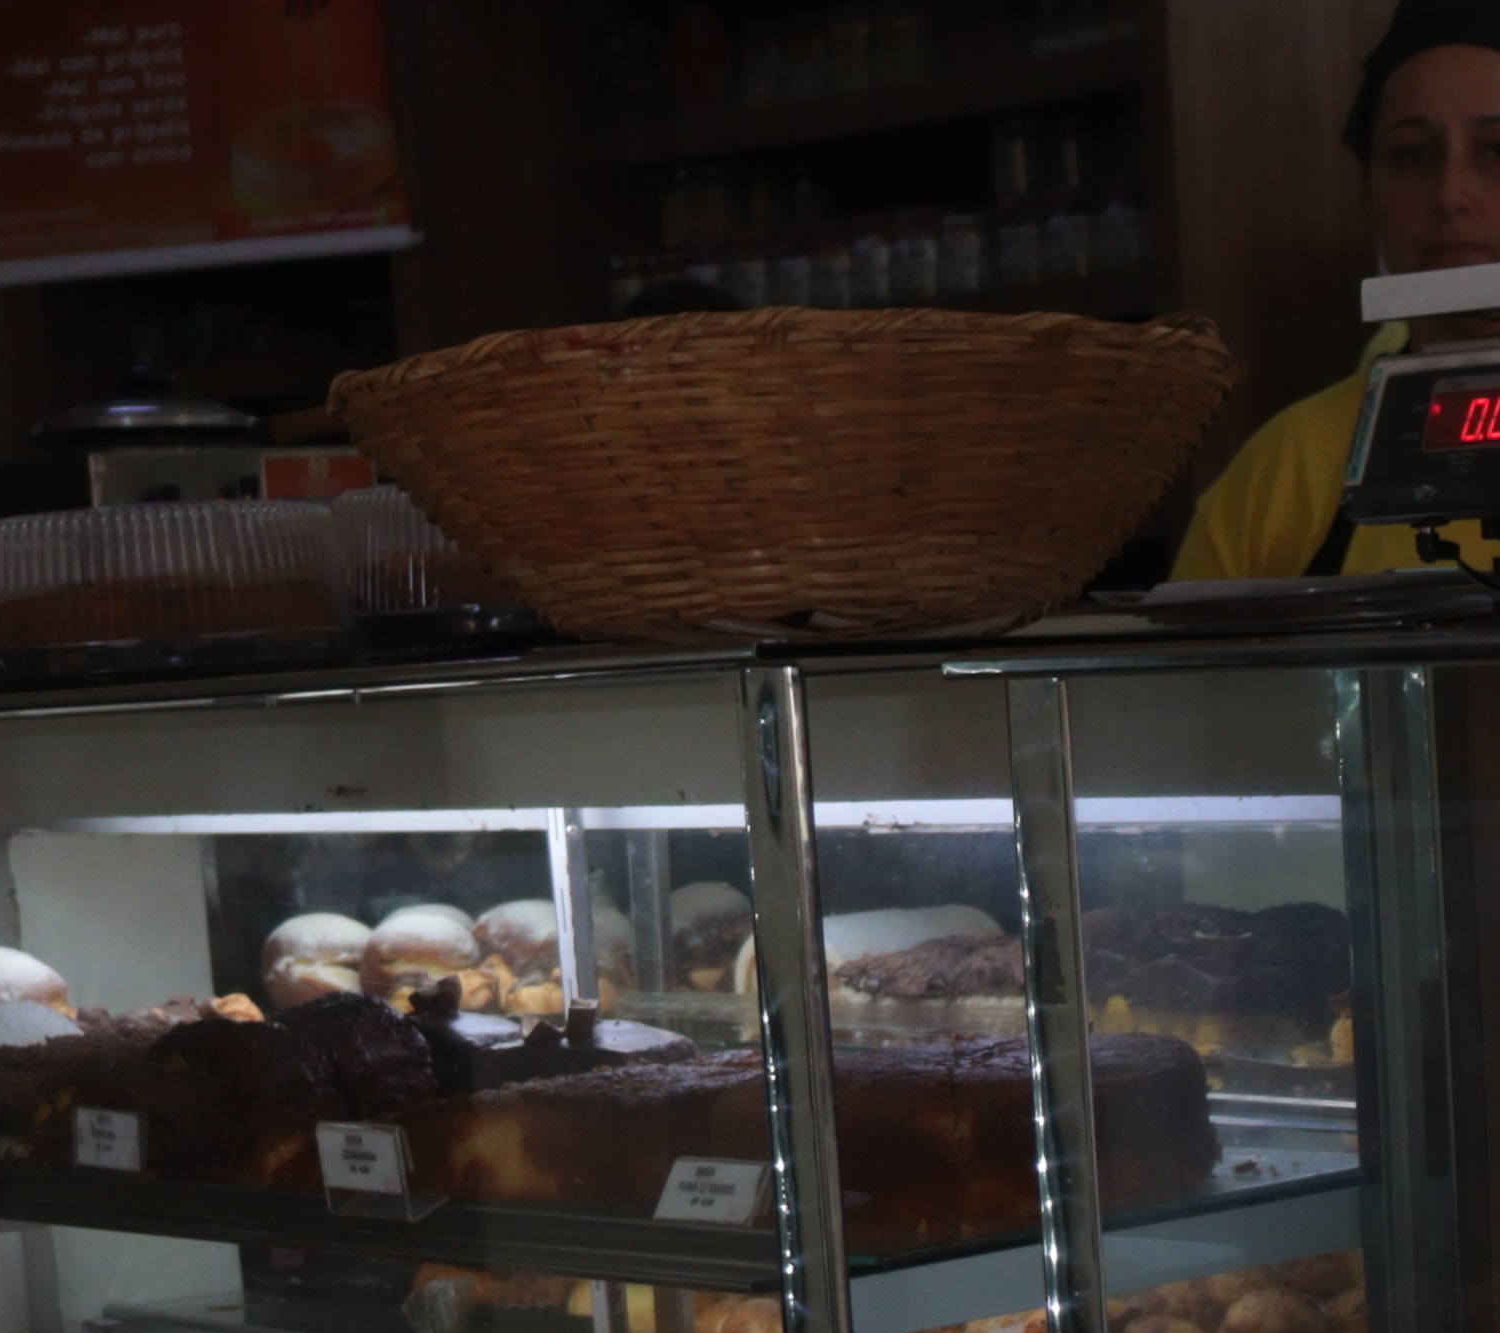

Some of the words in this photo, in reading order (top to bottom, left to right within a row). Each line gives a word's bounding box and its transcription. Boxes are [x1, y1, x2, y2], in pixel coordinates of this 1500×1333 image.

[136, 21, 183, 44] puro
[59, 55, 98, 73] com
[97, 76, 136, 92] com
[131, 95, 188, 114] verde
[80, 125, 104, 144] de
[85, 150, 124, 168] com
